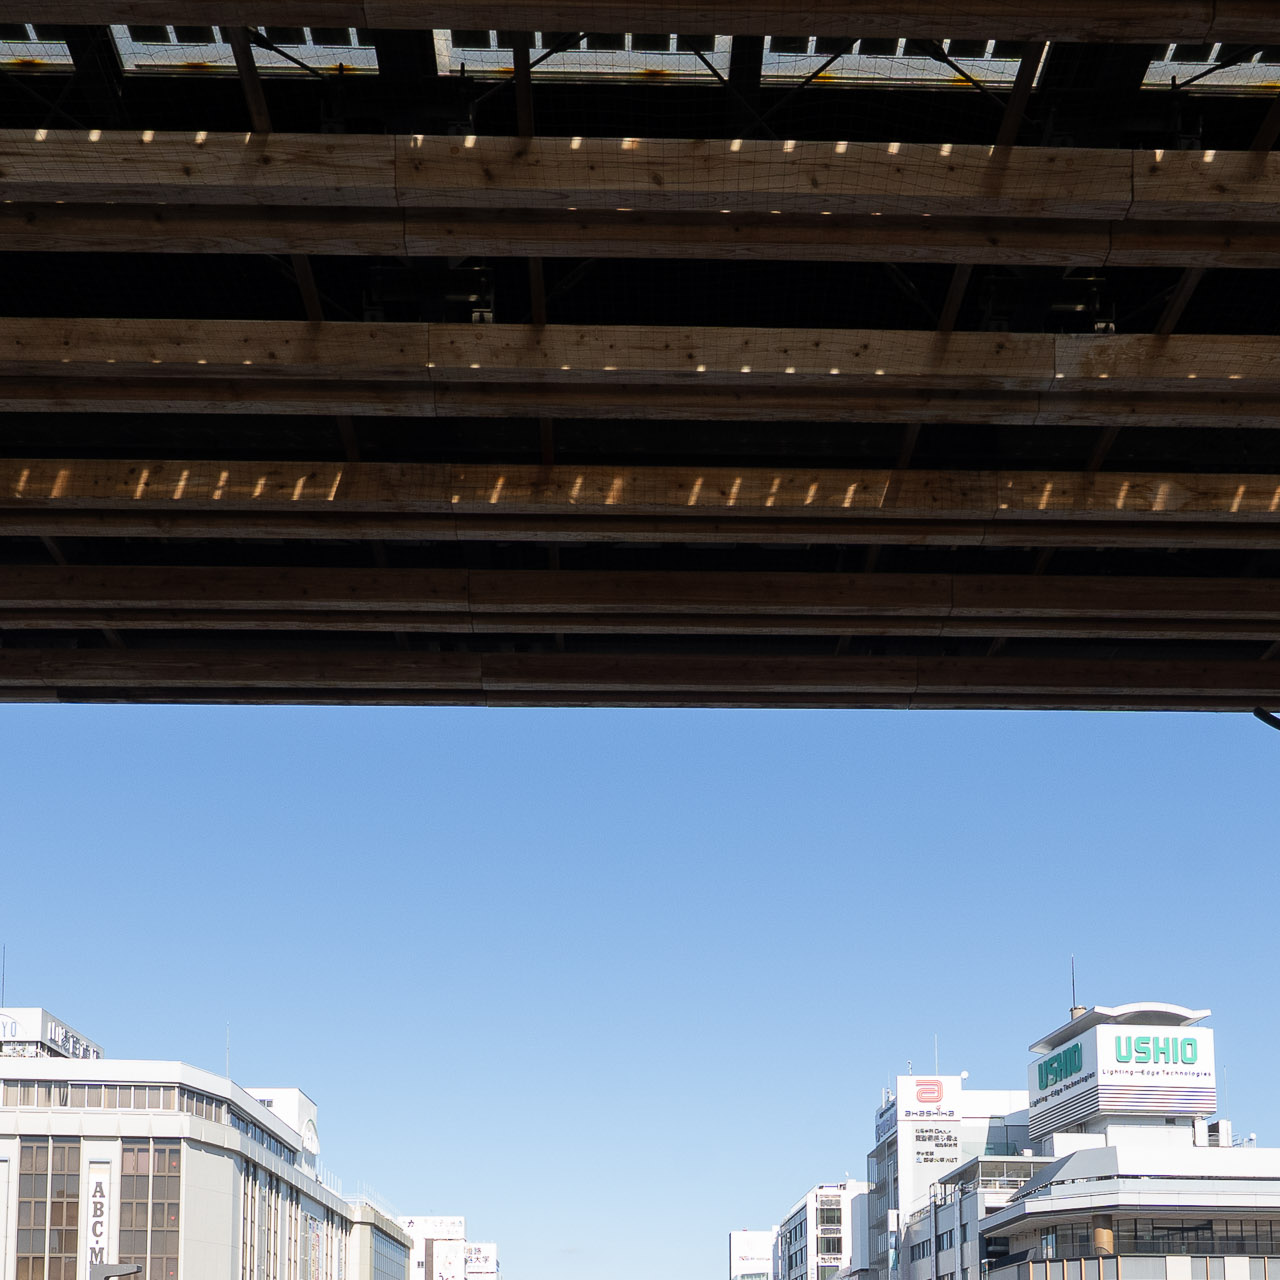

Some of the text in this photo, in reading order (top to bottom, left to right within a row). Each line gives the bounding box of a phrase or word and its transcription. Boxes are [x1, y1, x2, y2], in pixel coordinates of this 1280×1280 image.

[1115, 1035, 1198, 1065] USHIO
[1037, 1042, 1083, 1091] USHIO
[1162, 1070, 1211, 1078] Technologies
[1063, 1071, 1096, 1090] Technologies
